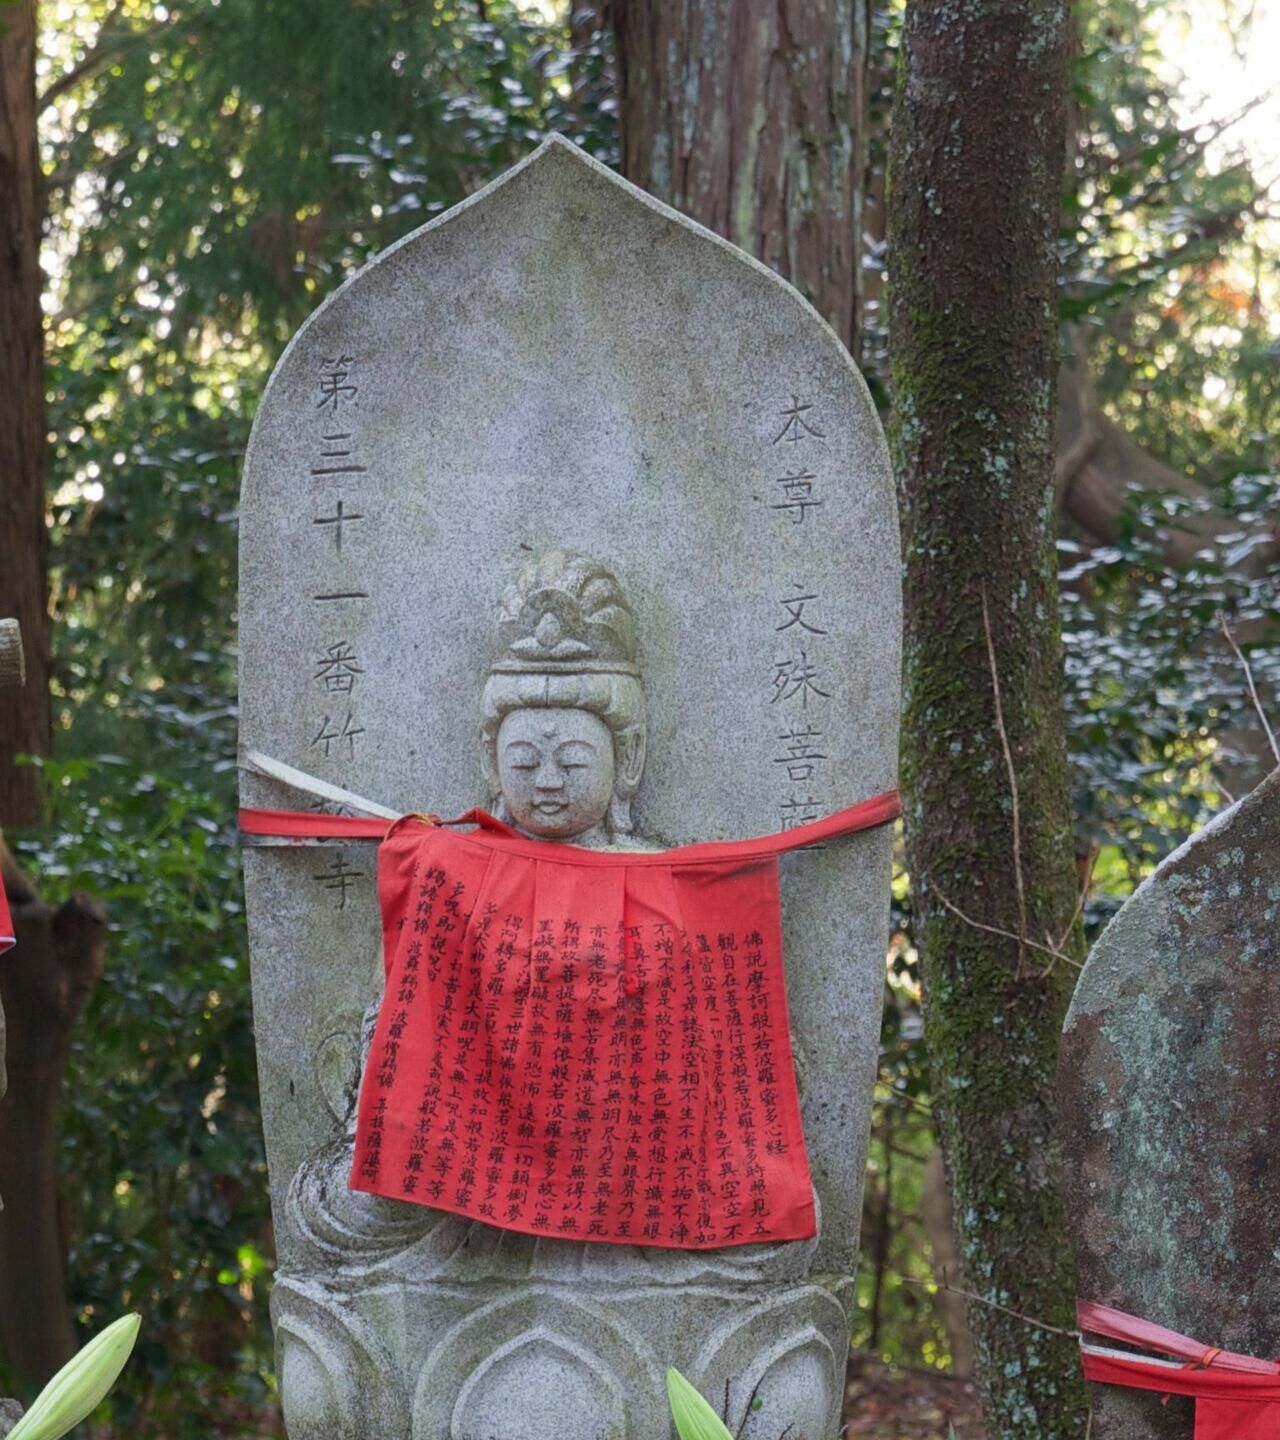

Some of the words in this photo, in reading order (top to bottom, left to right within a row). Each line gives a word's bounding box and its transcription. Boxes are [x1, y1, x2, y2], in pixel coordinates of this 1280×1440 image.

[772, 394, 827, 525] 本尊
[310, 355, 369, 911] 第三十一番竹寺
